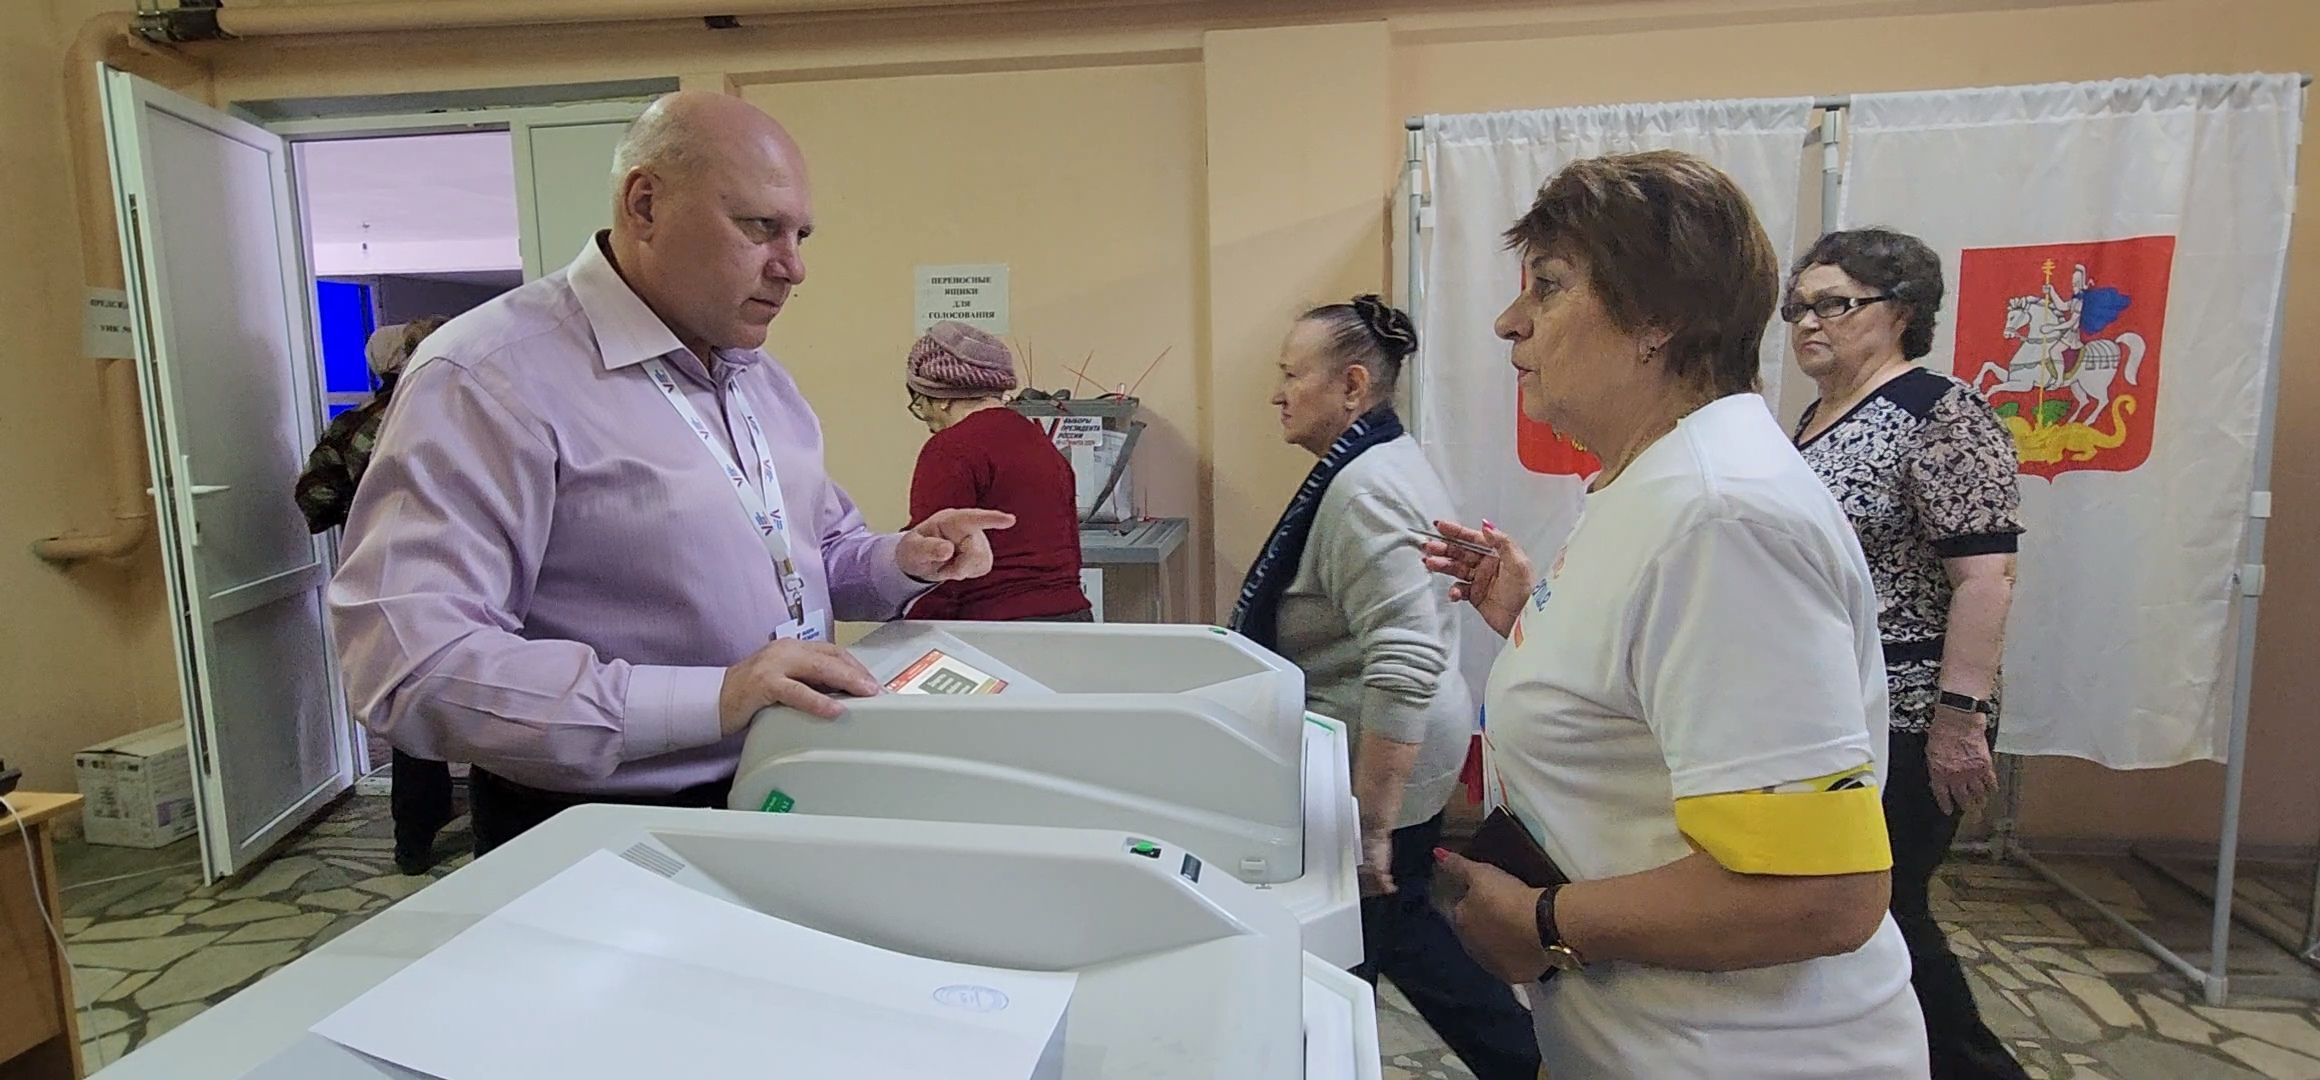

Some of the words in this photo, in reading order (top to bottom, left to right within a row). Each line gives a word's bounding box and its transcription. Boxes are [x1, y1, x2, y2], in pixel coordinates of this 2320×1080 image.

[931, 276, 992, 284] ПЕРЕНОСНЫЕ
[944, 288, 978, 296] ЯЩИКИ
[952, 300, 971, 309] ДЛЯ
[928, 311, 995, 320] ГОЛОСОВАНИЯ
